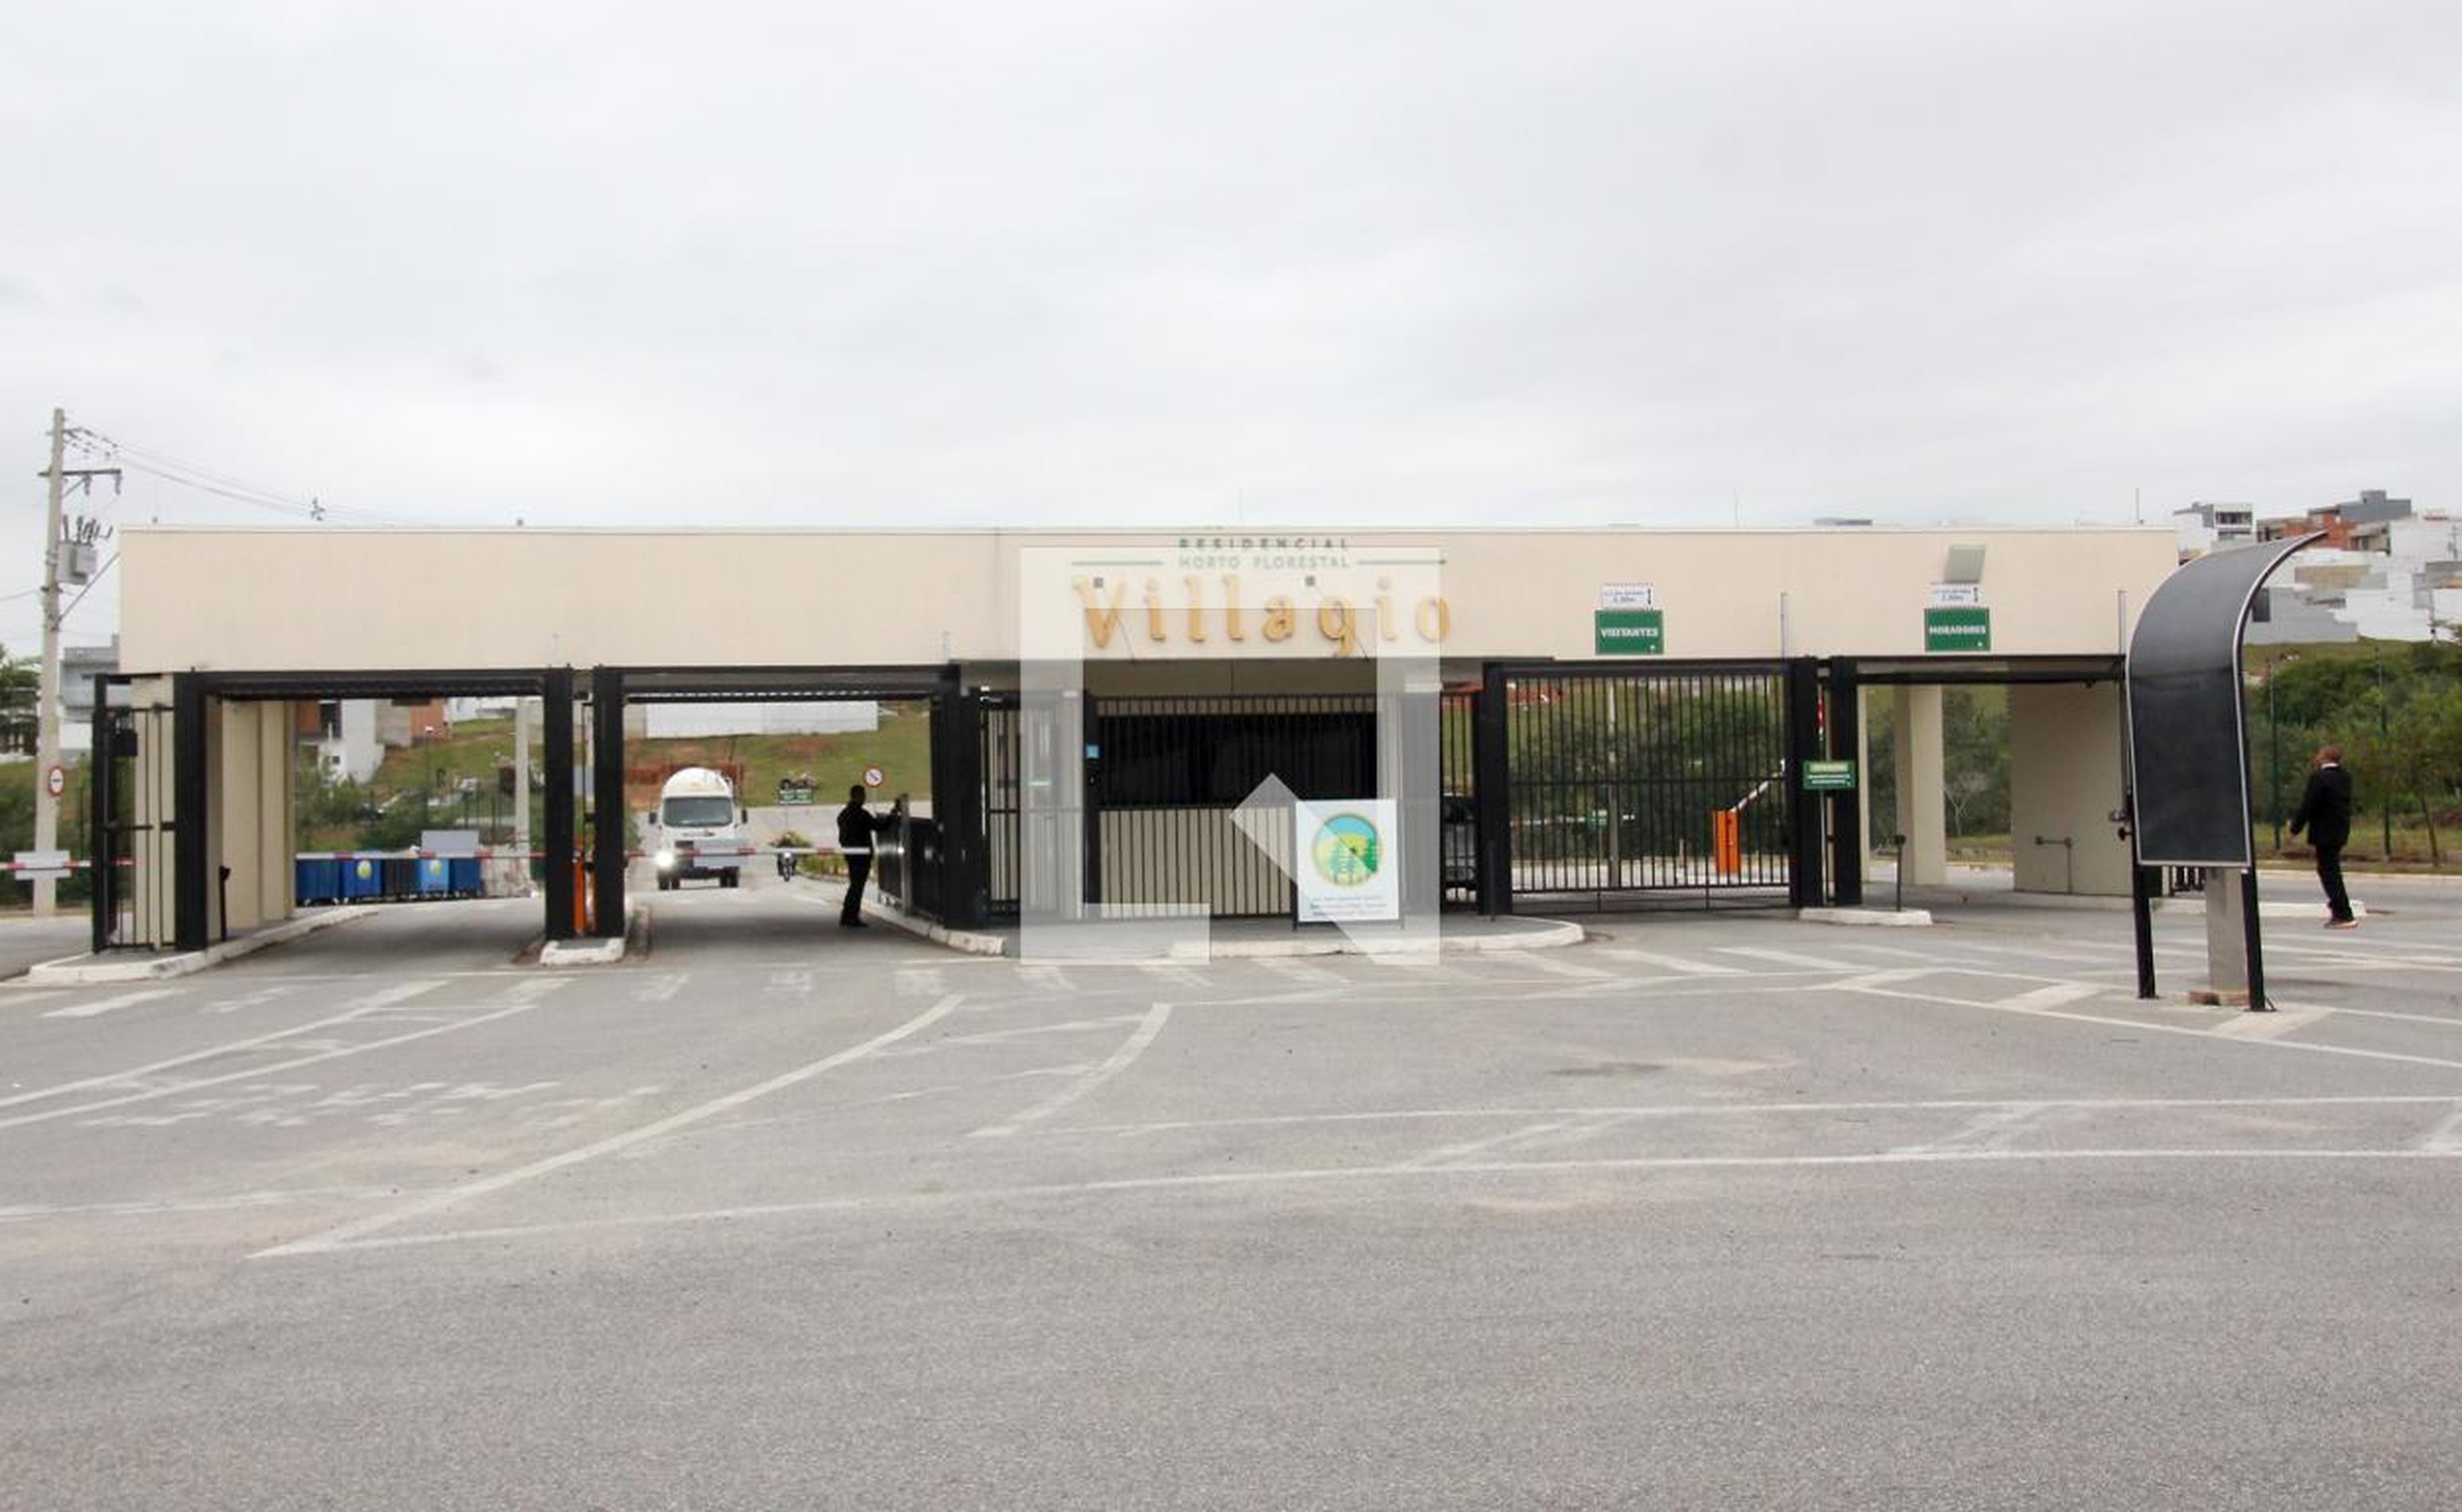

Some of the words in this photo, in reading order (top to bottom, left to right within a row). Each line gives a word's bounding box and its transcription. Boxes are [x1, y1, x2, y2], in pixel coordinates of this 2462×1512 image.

[1179, 538, 1348, 549] RESIDENCIAL
[1178, 555, 1240, 569] HORTO
[1253, 555, 1350, 569] FLORESTAL
[1071, 575, 1450, 658] Villagio
[1601, 628, 1658, 638] VISITANTES
